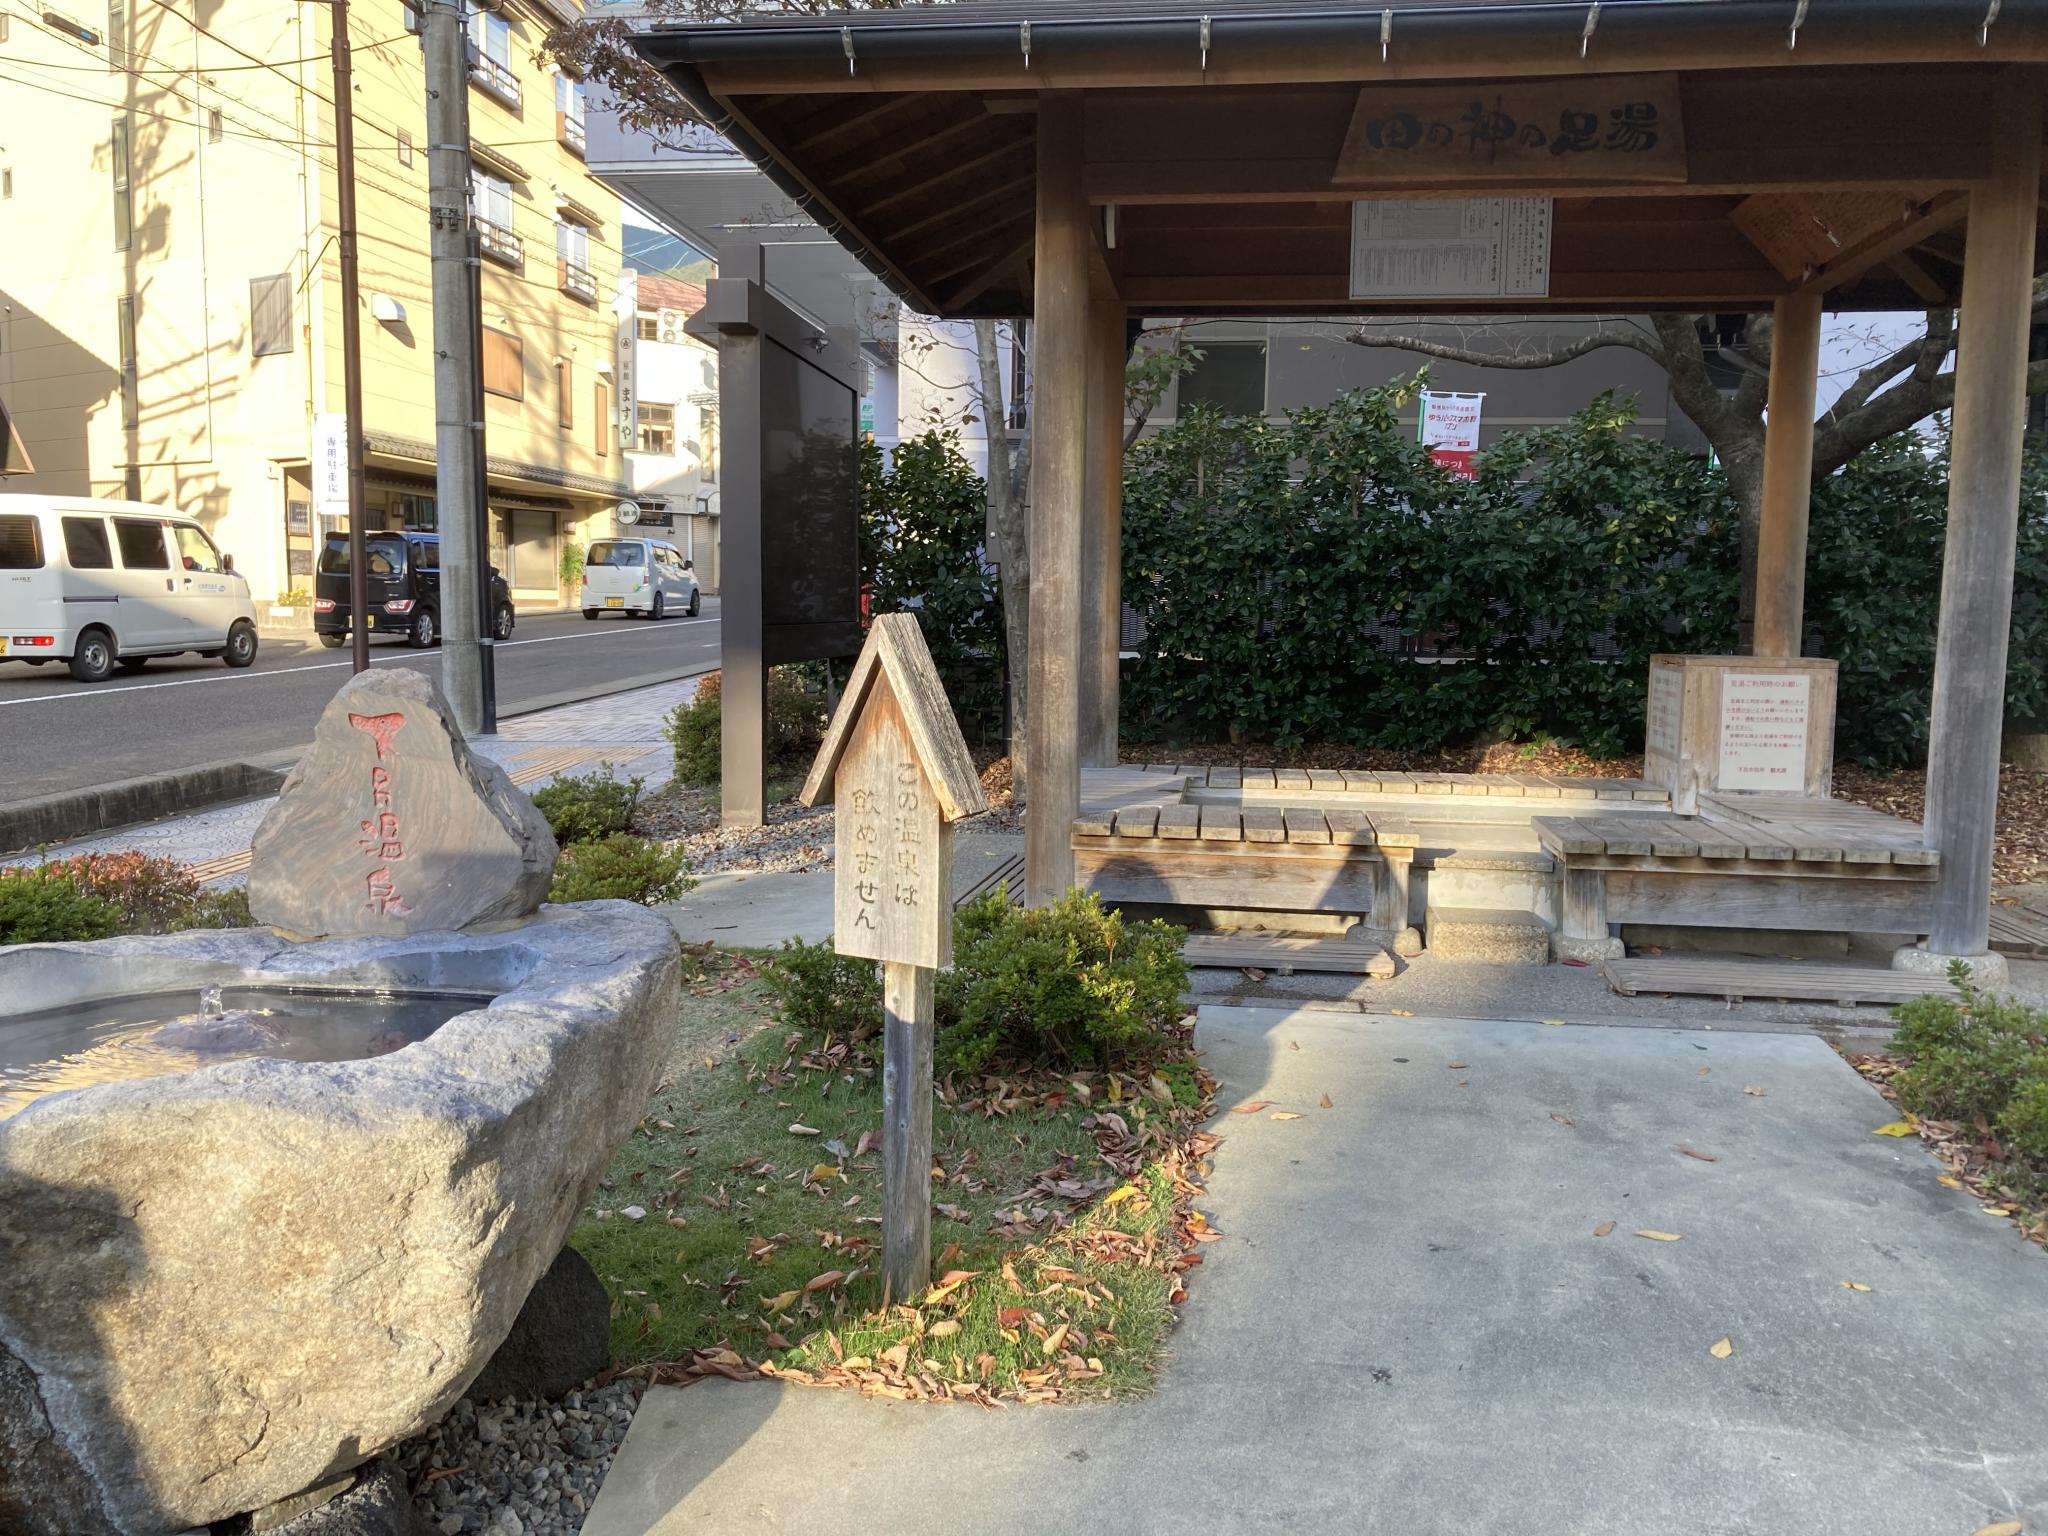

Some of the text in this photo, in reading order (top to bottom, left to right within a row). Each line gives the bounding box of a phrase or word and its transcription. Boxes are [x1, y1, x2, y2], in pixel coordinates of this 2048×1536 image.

[1365, 94, 1660, 165] 田の神の足湯
[327, 437, 338, 494] 専用駐車場
[621, 387, 632, 440] ますや
[348, 712, 413, 916] 下呂温泉
[852, 788, 881, 930] 飲めません
[895, 762, 922, 907] この温泉は
